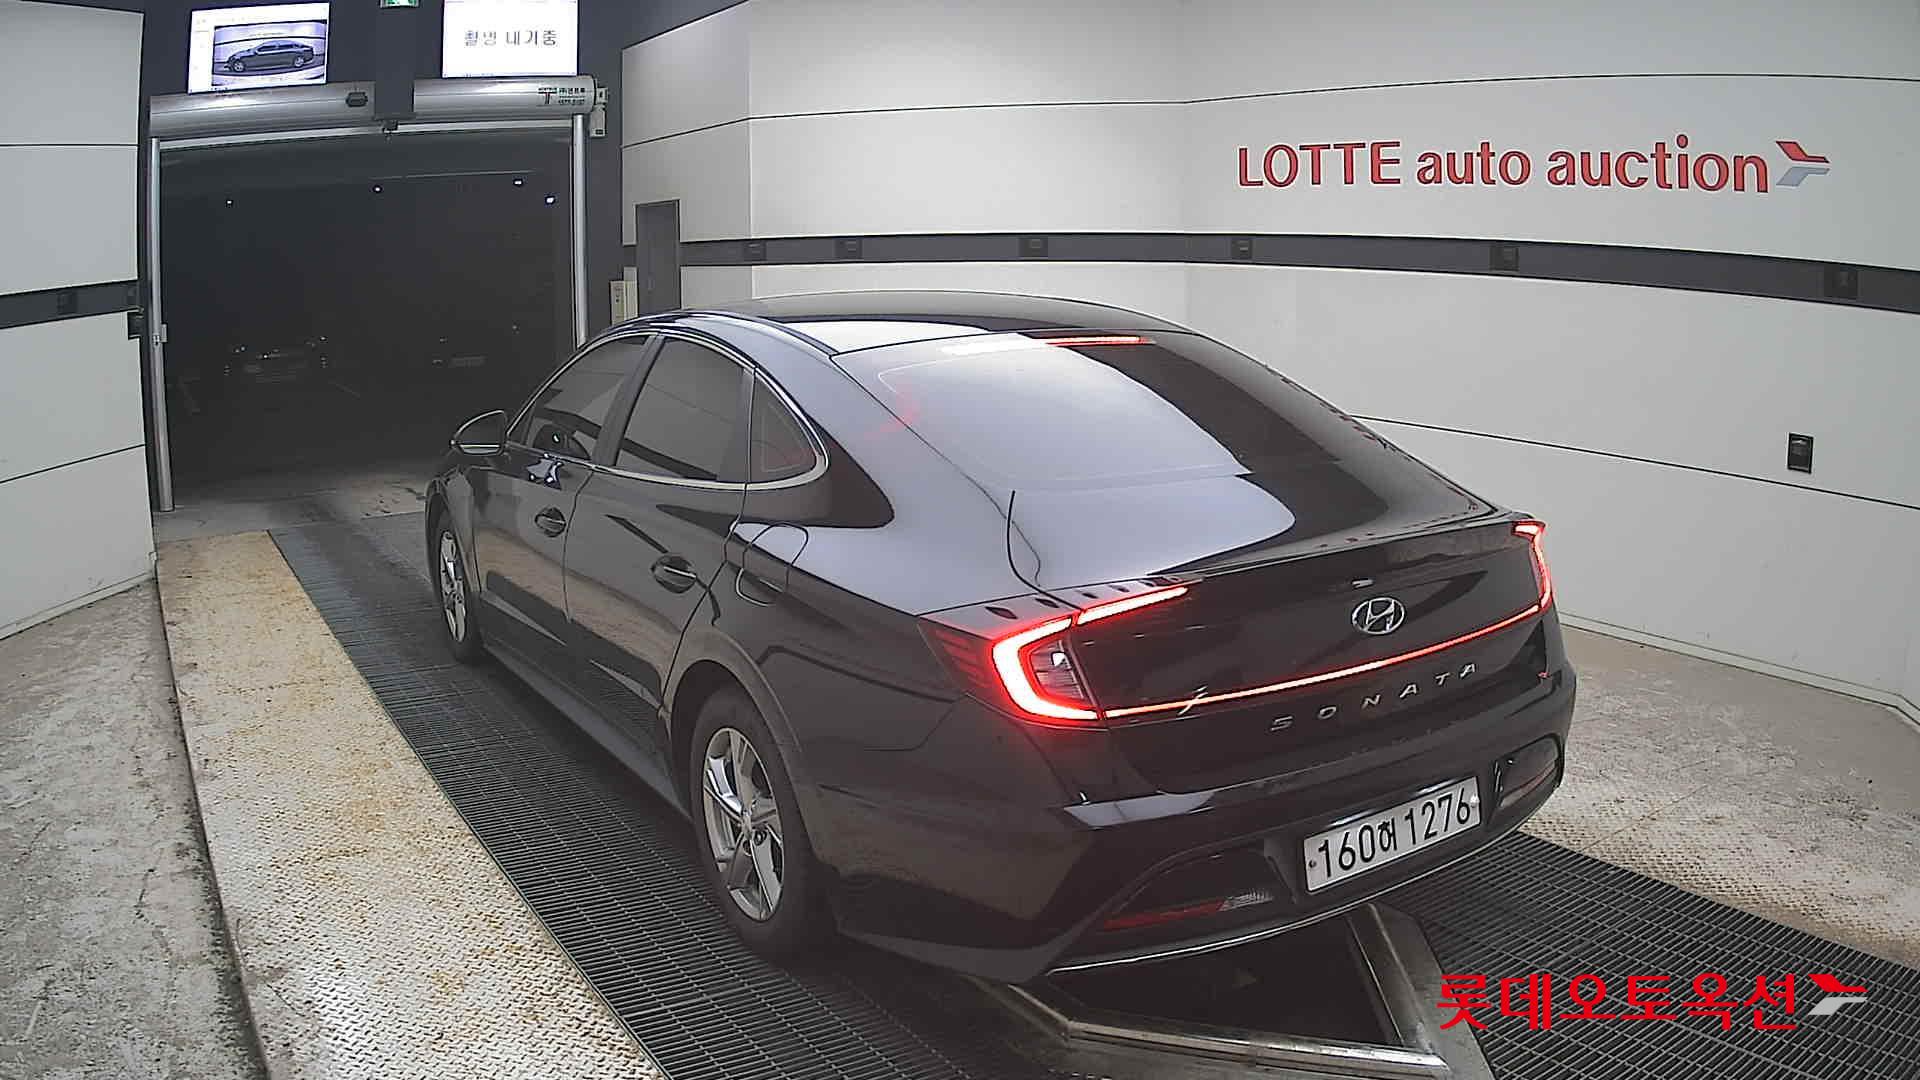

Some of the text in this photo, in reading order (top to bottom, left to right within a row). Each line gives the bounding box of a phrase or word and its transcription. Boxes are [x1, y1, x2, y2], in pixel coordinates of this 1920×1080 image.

[1238, 134, 1769, 193] LOTTE auto auction
[1270, 663, 1477, 732] SONATA
